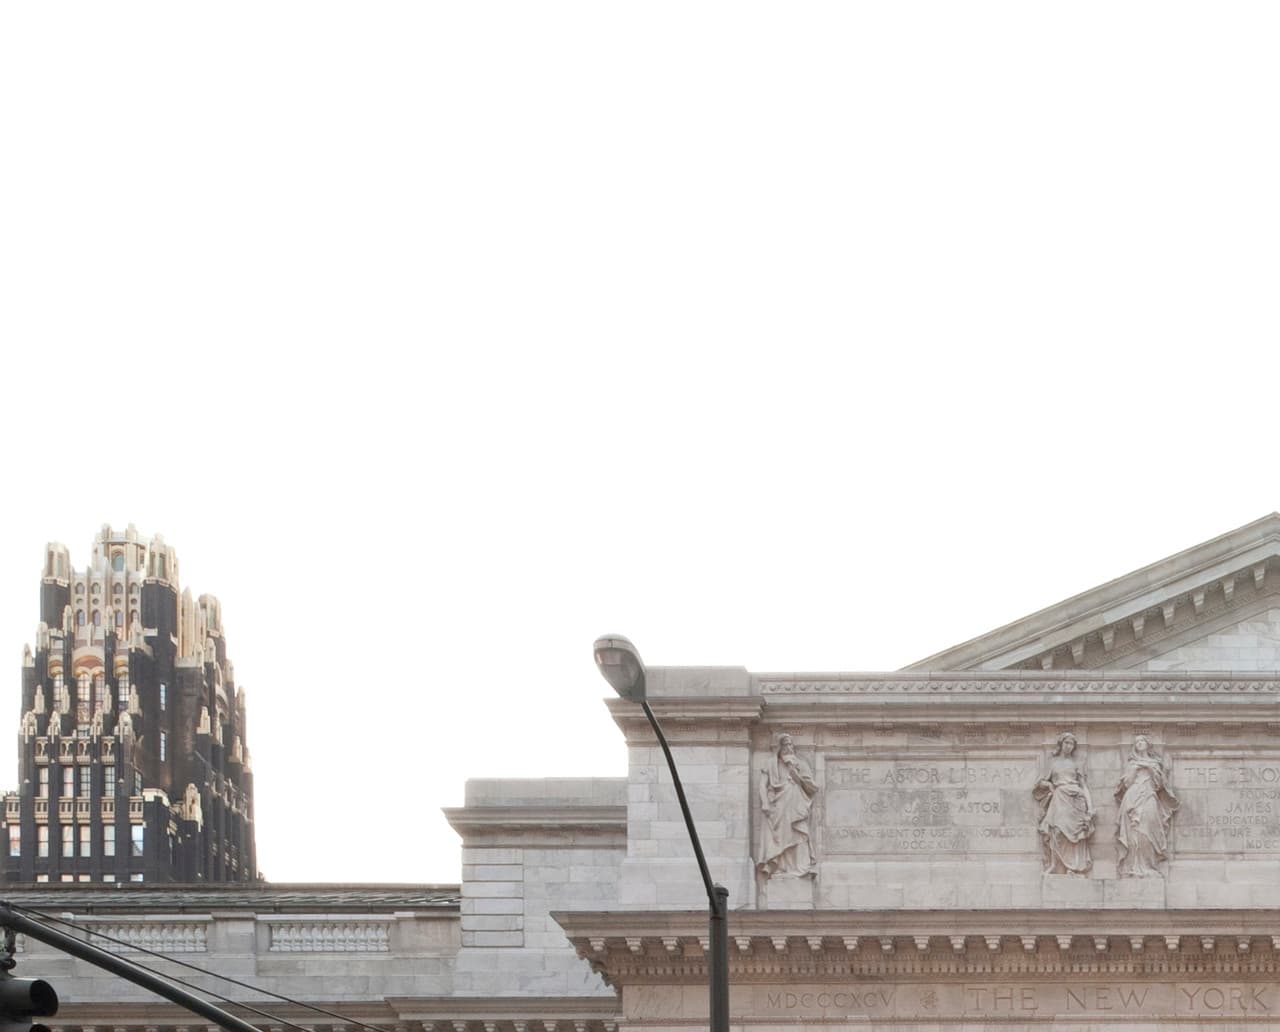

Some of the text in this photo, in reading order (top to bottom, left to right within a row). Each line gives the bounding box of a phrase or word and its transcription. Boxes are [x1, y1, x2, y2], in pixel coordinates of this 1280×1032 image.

[839, 767, 1026, 784] THE ASTOR LIBRARY
[1184, 767, 1218, 784] THE
[958, 802, 1001, 814] ASTOR
[1225, 802, 1272, 814] JAMES
[1208, 816, 1268, 826] DEDICATED
[767, 991, 897, 1010] MDCCCXCV
[968, 987, 1039, 1011] THE
[1065, 987, 1151, 1011] NEW
[1181, 987, 1270, 1011] YORK
